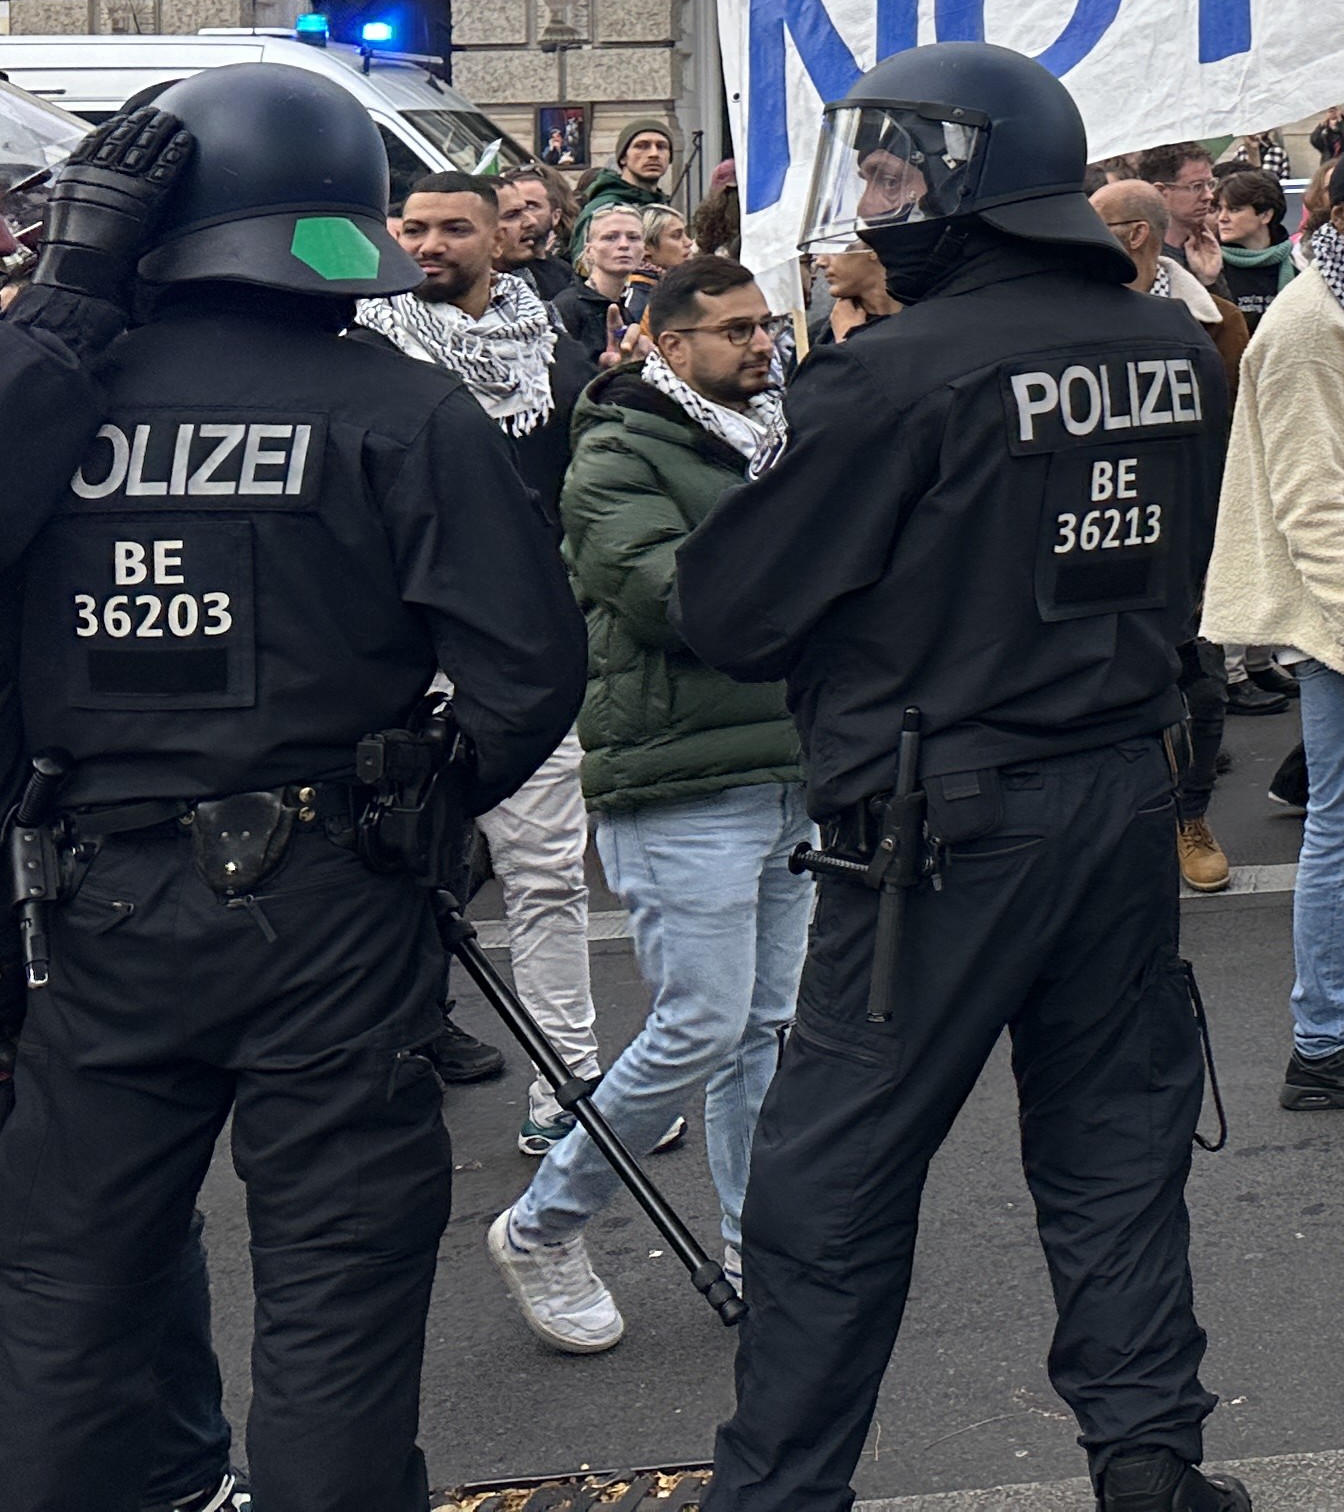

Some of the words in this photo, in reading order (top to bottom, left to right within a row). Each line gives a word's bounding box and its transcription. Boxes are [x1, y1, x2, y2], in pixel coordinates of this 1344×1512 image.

[1010, 359, 1202, 441] POLIZEI
[71, 424, 312, 499] OLIZEI
[1091, 458, 1138, 503] BE
[1054, 504, 1162, 554] 36213
[114, 540, 185, 585] BE
[74, 592, 233, 638] 36203
